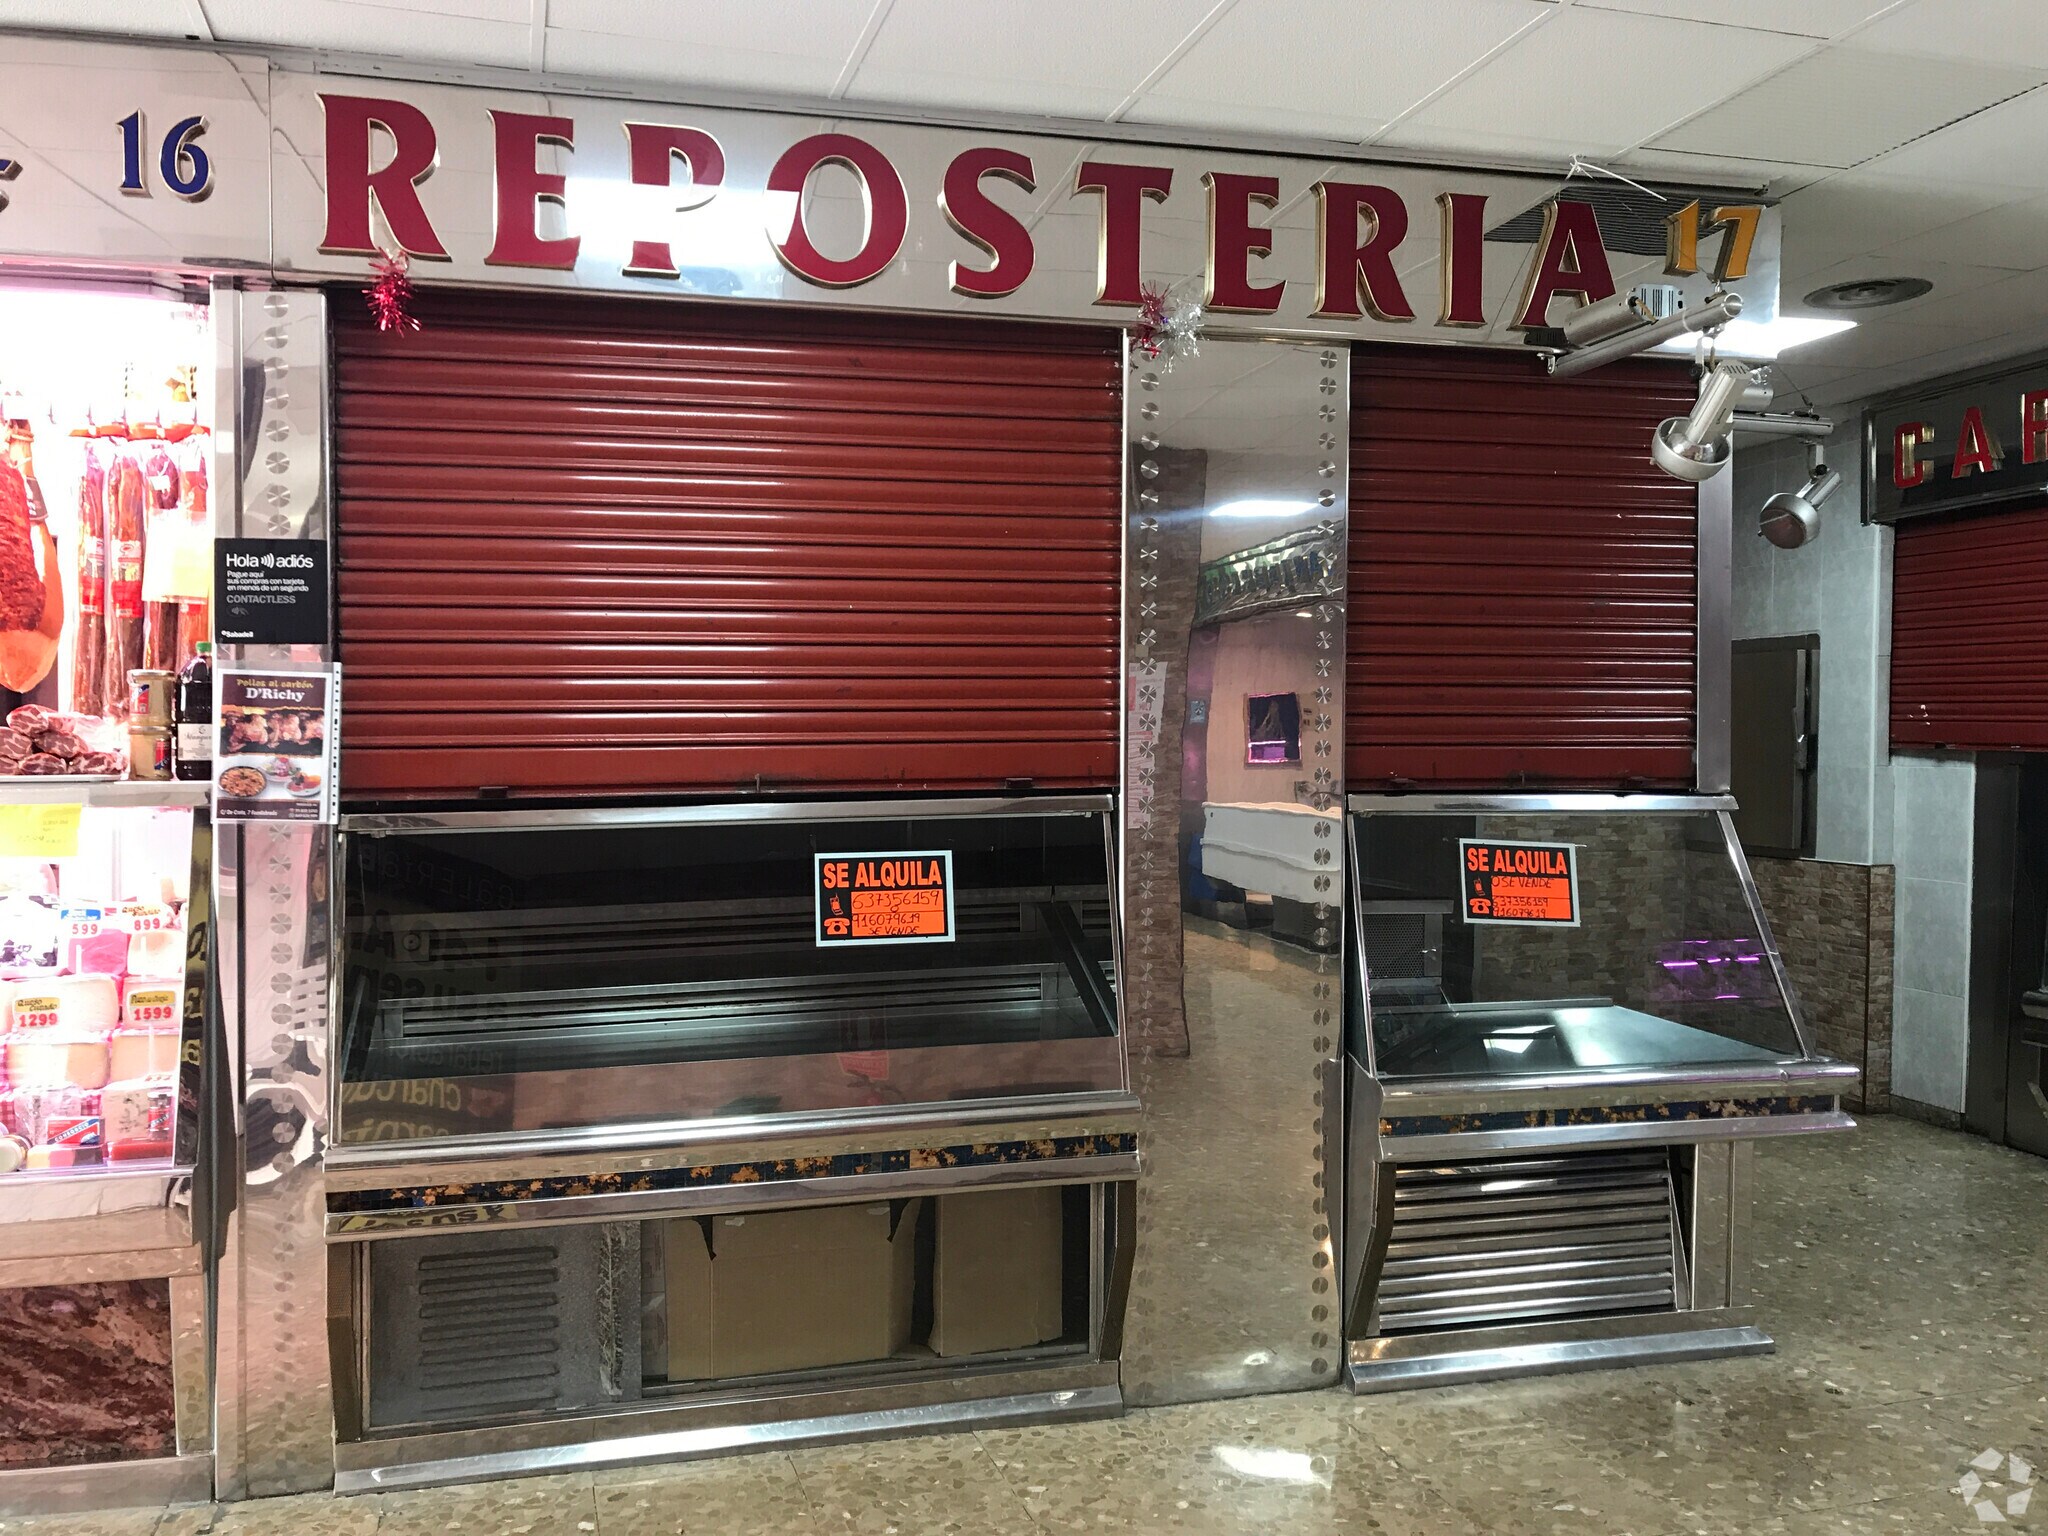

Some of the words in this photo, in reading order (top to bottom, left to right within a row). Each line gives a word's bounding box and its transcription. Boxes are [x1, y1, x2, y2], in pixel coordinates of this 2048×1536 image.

[116, 107, 214, 203] 16
[315, 92, 1617, 332] REPOSTERIA
[1661, 199, 1763, 282] 17
[226, 553, 259, 568] Hola
[276, 554, 314, 569] adiós
[240, 578, 268, 586] compras
[280, 585, 309, 594] segundo
[226, 594, 296, 604] CONTACTLESS
[1467, 847, 1490, 872] SE
[1493, 849, 1568, 876] ALQUILA
[823, 862, 850, 889] SE
[855, 860, 942, 888] ALQUILA
[72, 923, 98, 935] 599
[134, 918, 160, 930] 899
[19, 1012, 58, 1028] 1299
[134, 1006, 172, 1021] 1599
